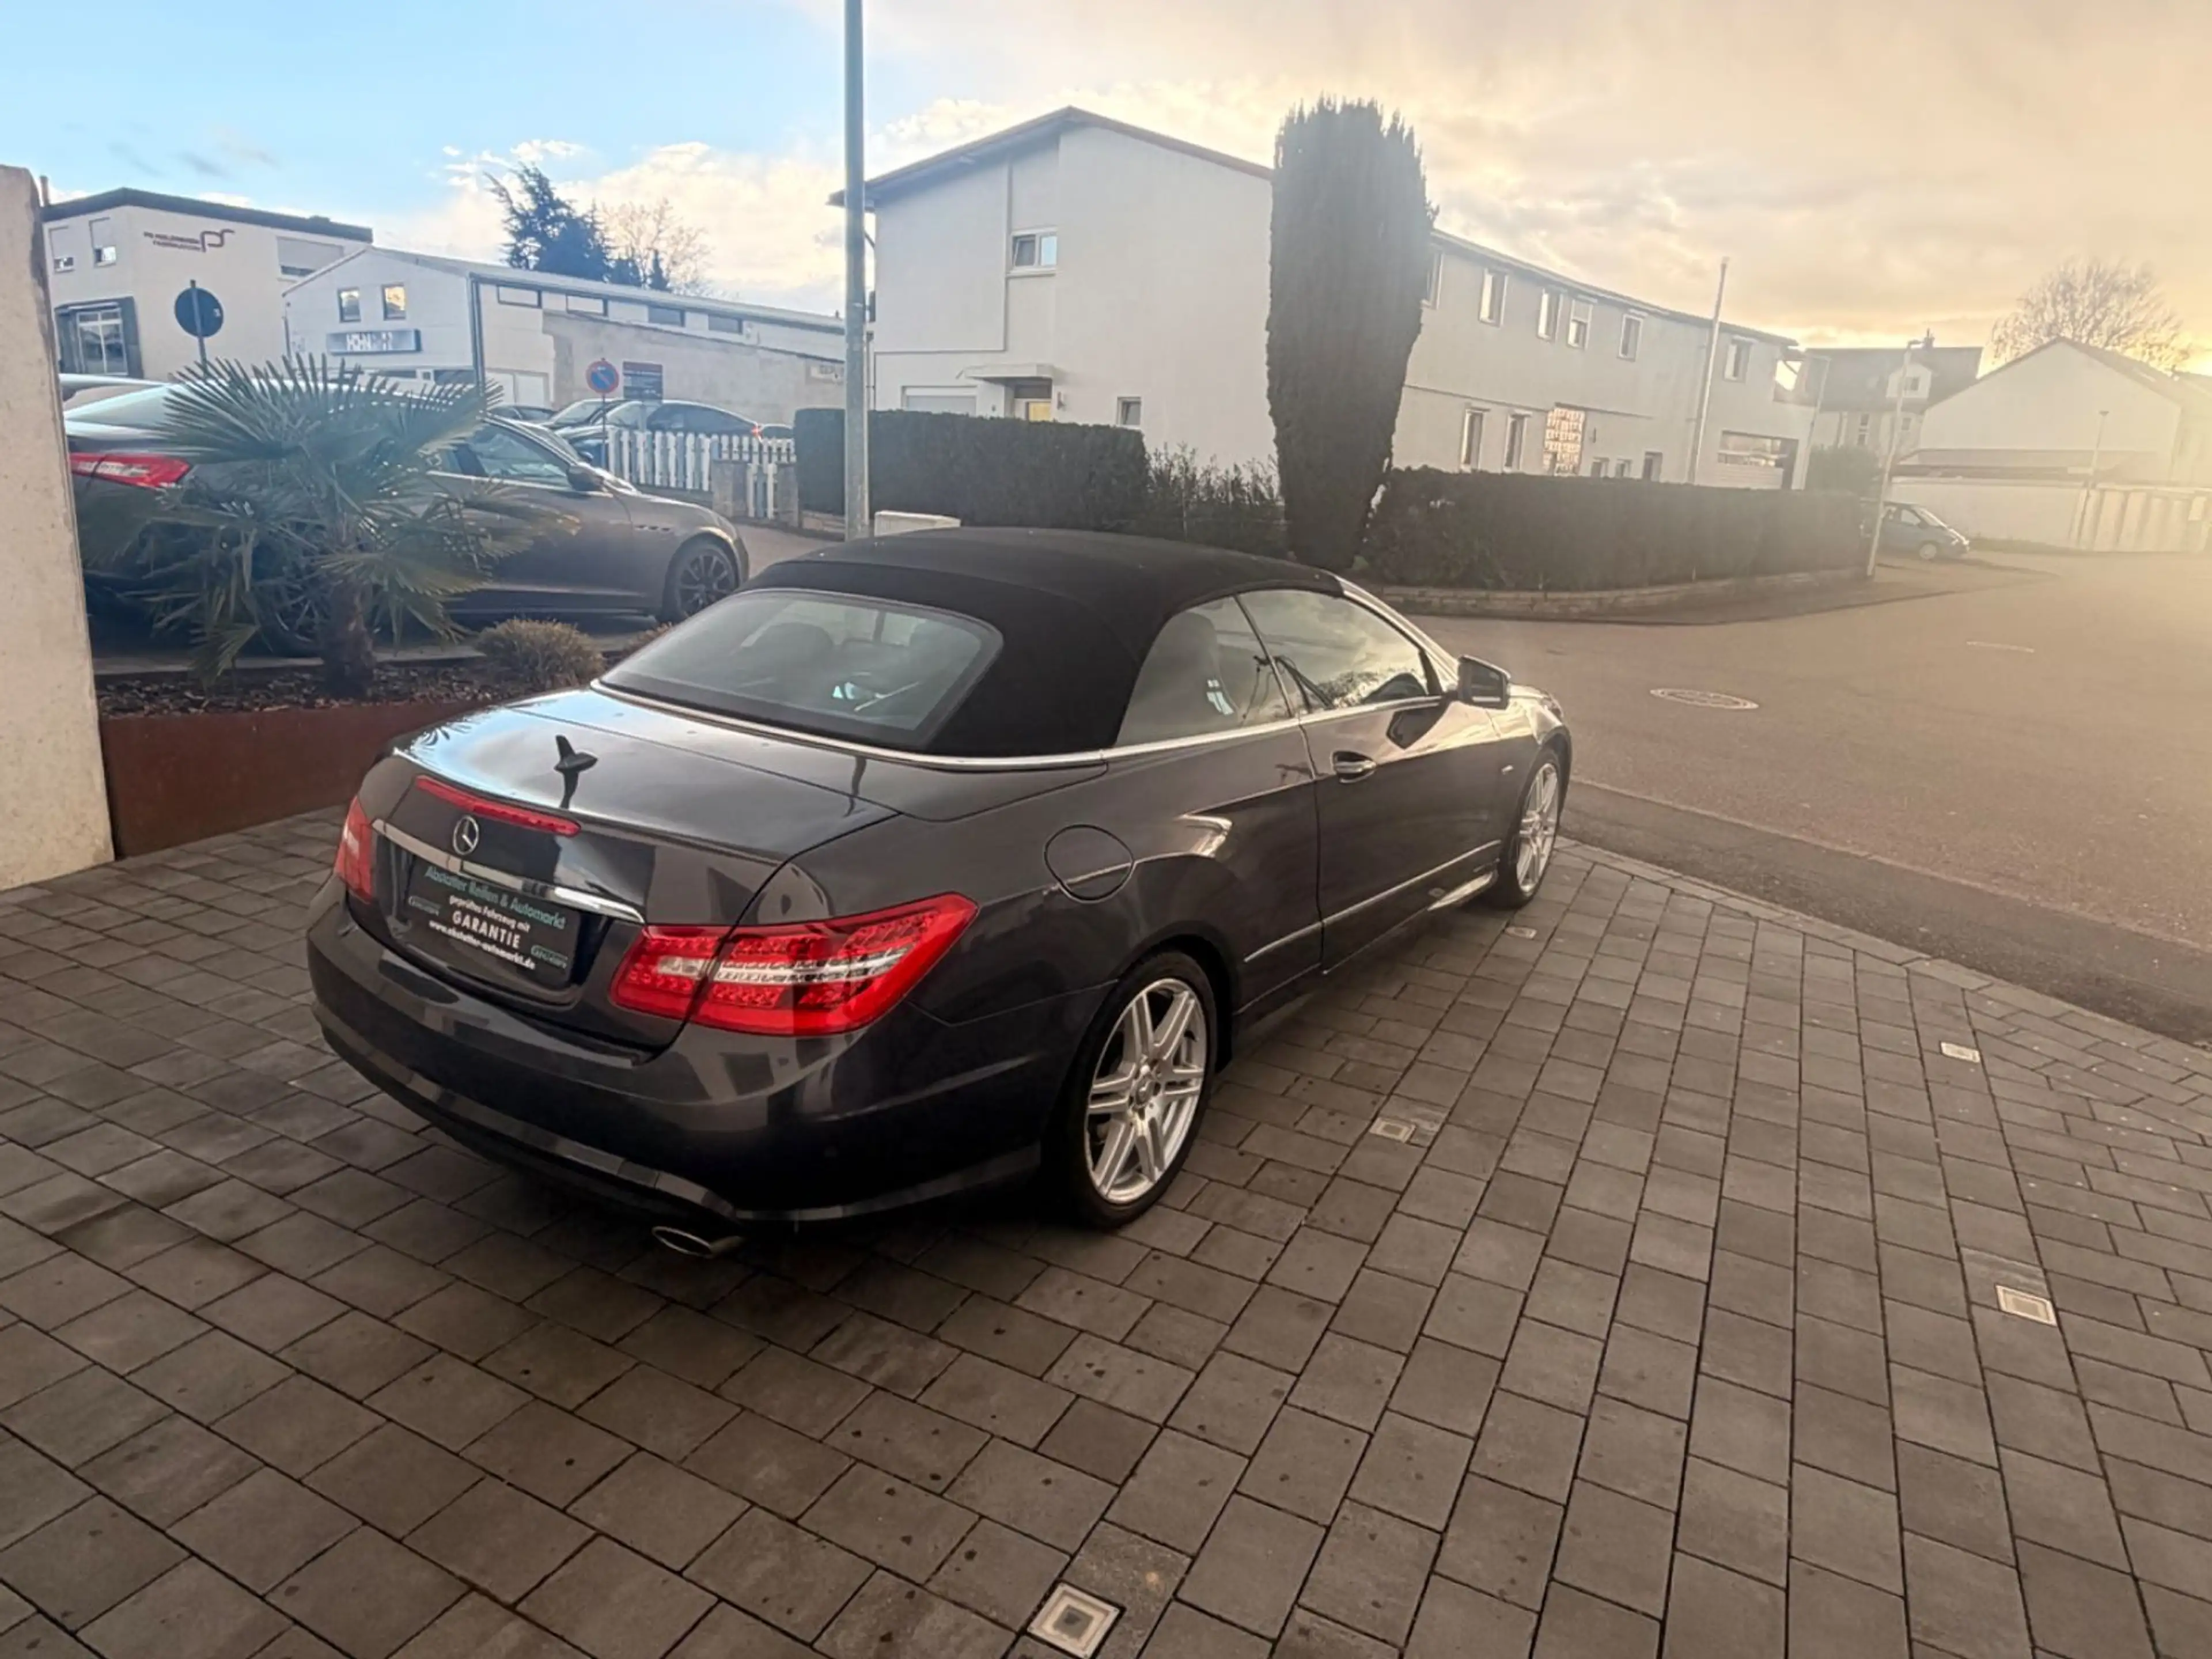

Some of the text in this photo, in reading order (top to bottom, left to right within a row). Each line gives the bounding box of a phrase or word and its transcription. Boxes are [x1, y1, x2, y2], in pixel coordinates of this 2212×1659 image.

[452, 910, 521, 949] GARANTIE
[499, 893, 508, 908] &
[510, 897, 566, 930] Automarkt
